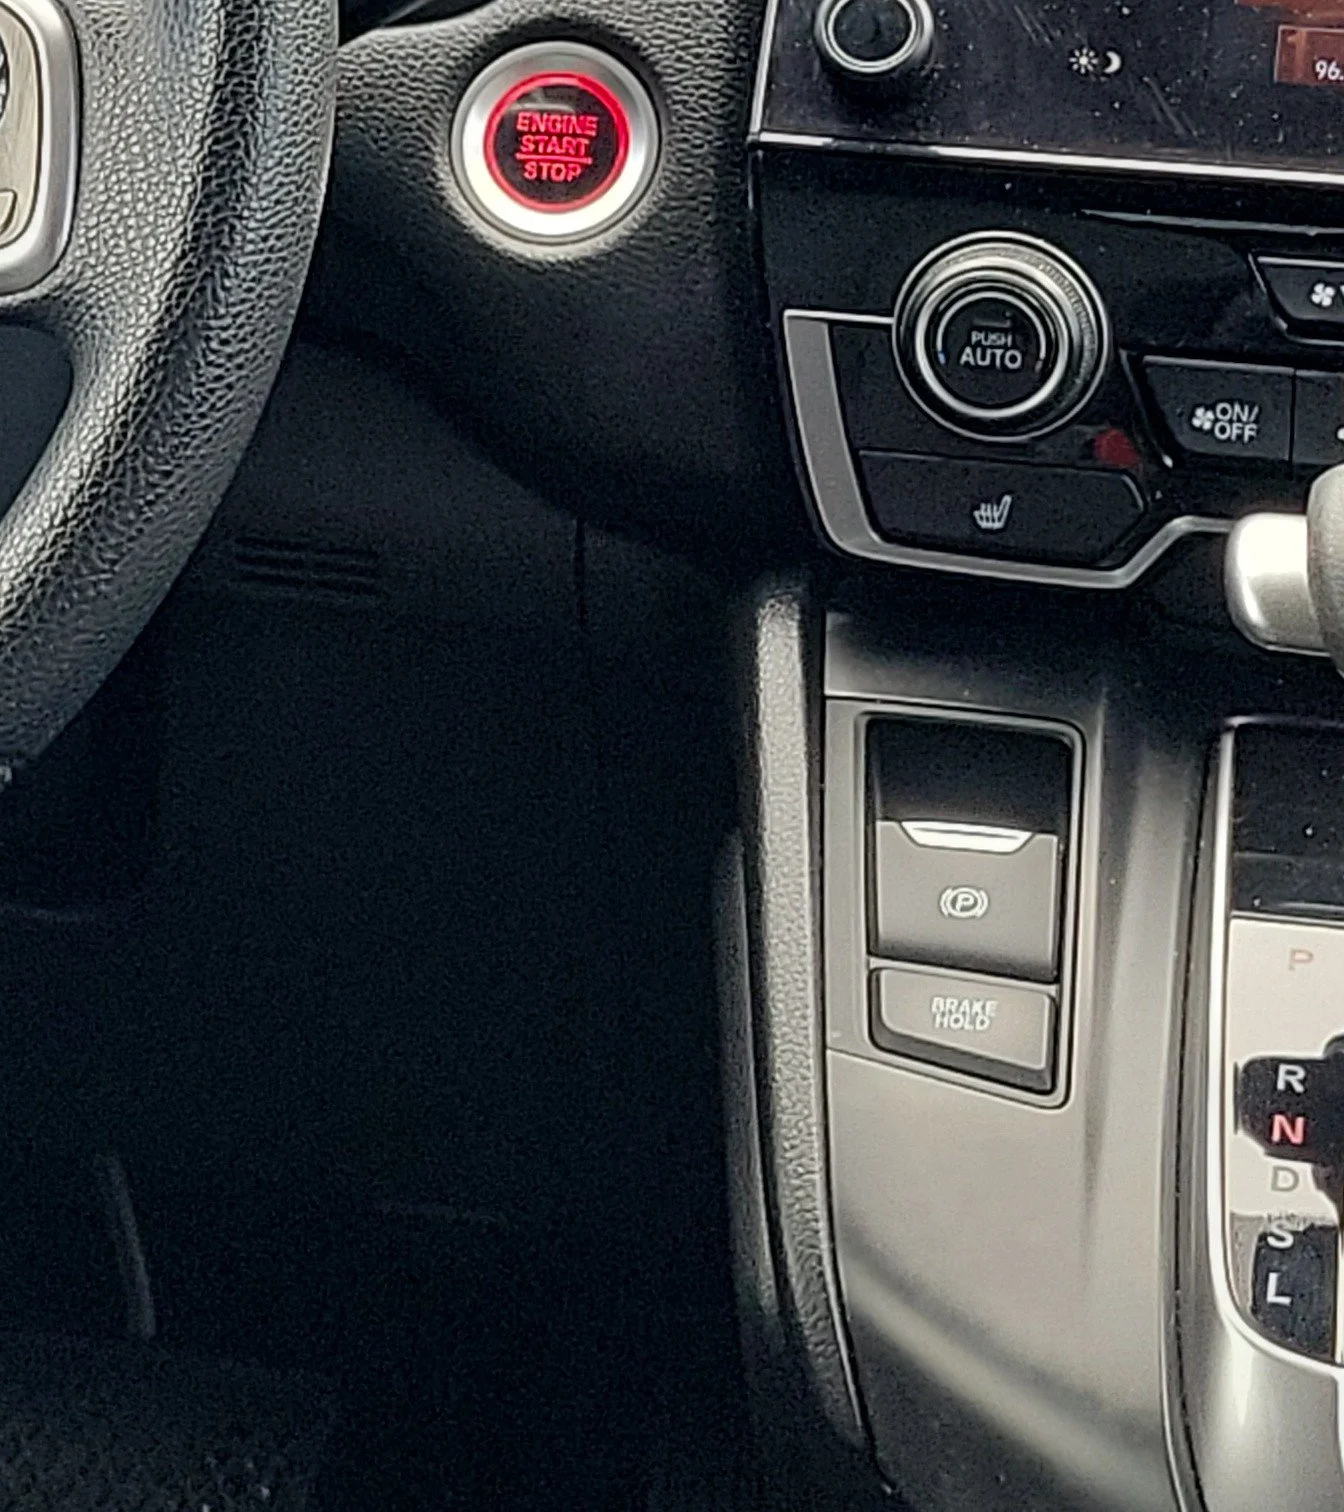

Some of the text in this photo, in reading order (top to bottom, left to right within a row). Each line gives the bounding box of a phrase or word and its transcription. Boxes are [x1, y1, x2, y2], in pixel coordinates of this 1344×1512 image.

[516, 111, 599, 137] ENGINE
[520, 134, 590, 156] START
[523, 161, 581, 183] STOP
[971, 329, 1013, 348] PUSH
[960, 347, 1024, 370] AUTO
[1215, 402, 1259, 424] ON/
[1213, 421, 1258, 443] OFF
[1288, 947, 1315, 971] P
[931, 996, 998, 1020] BRAKE
[934, 1011, 991, 1032] HOLD
[1276, 1063, 1307, 1093] R
[1270, 1114, 1306, 1146] N
[1270, 1165, 1300, 1192] D
[1266, 1218, 1295, 1249] S
[1266, 1272, 1292, 1306] L
